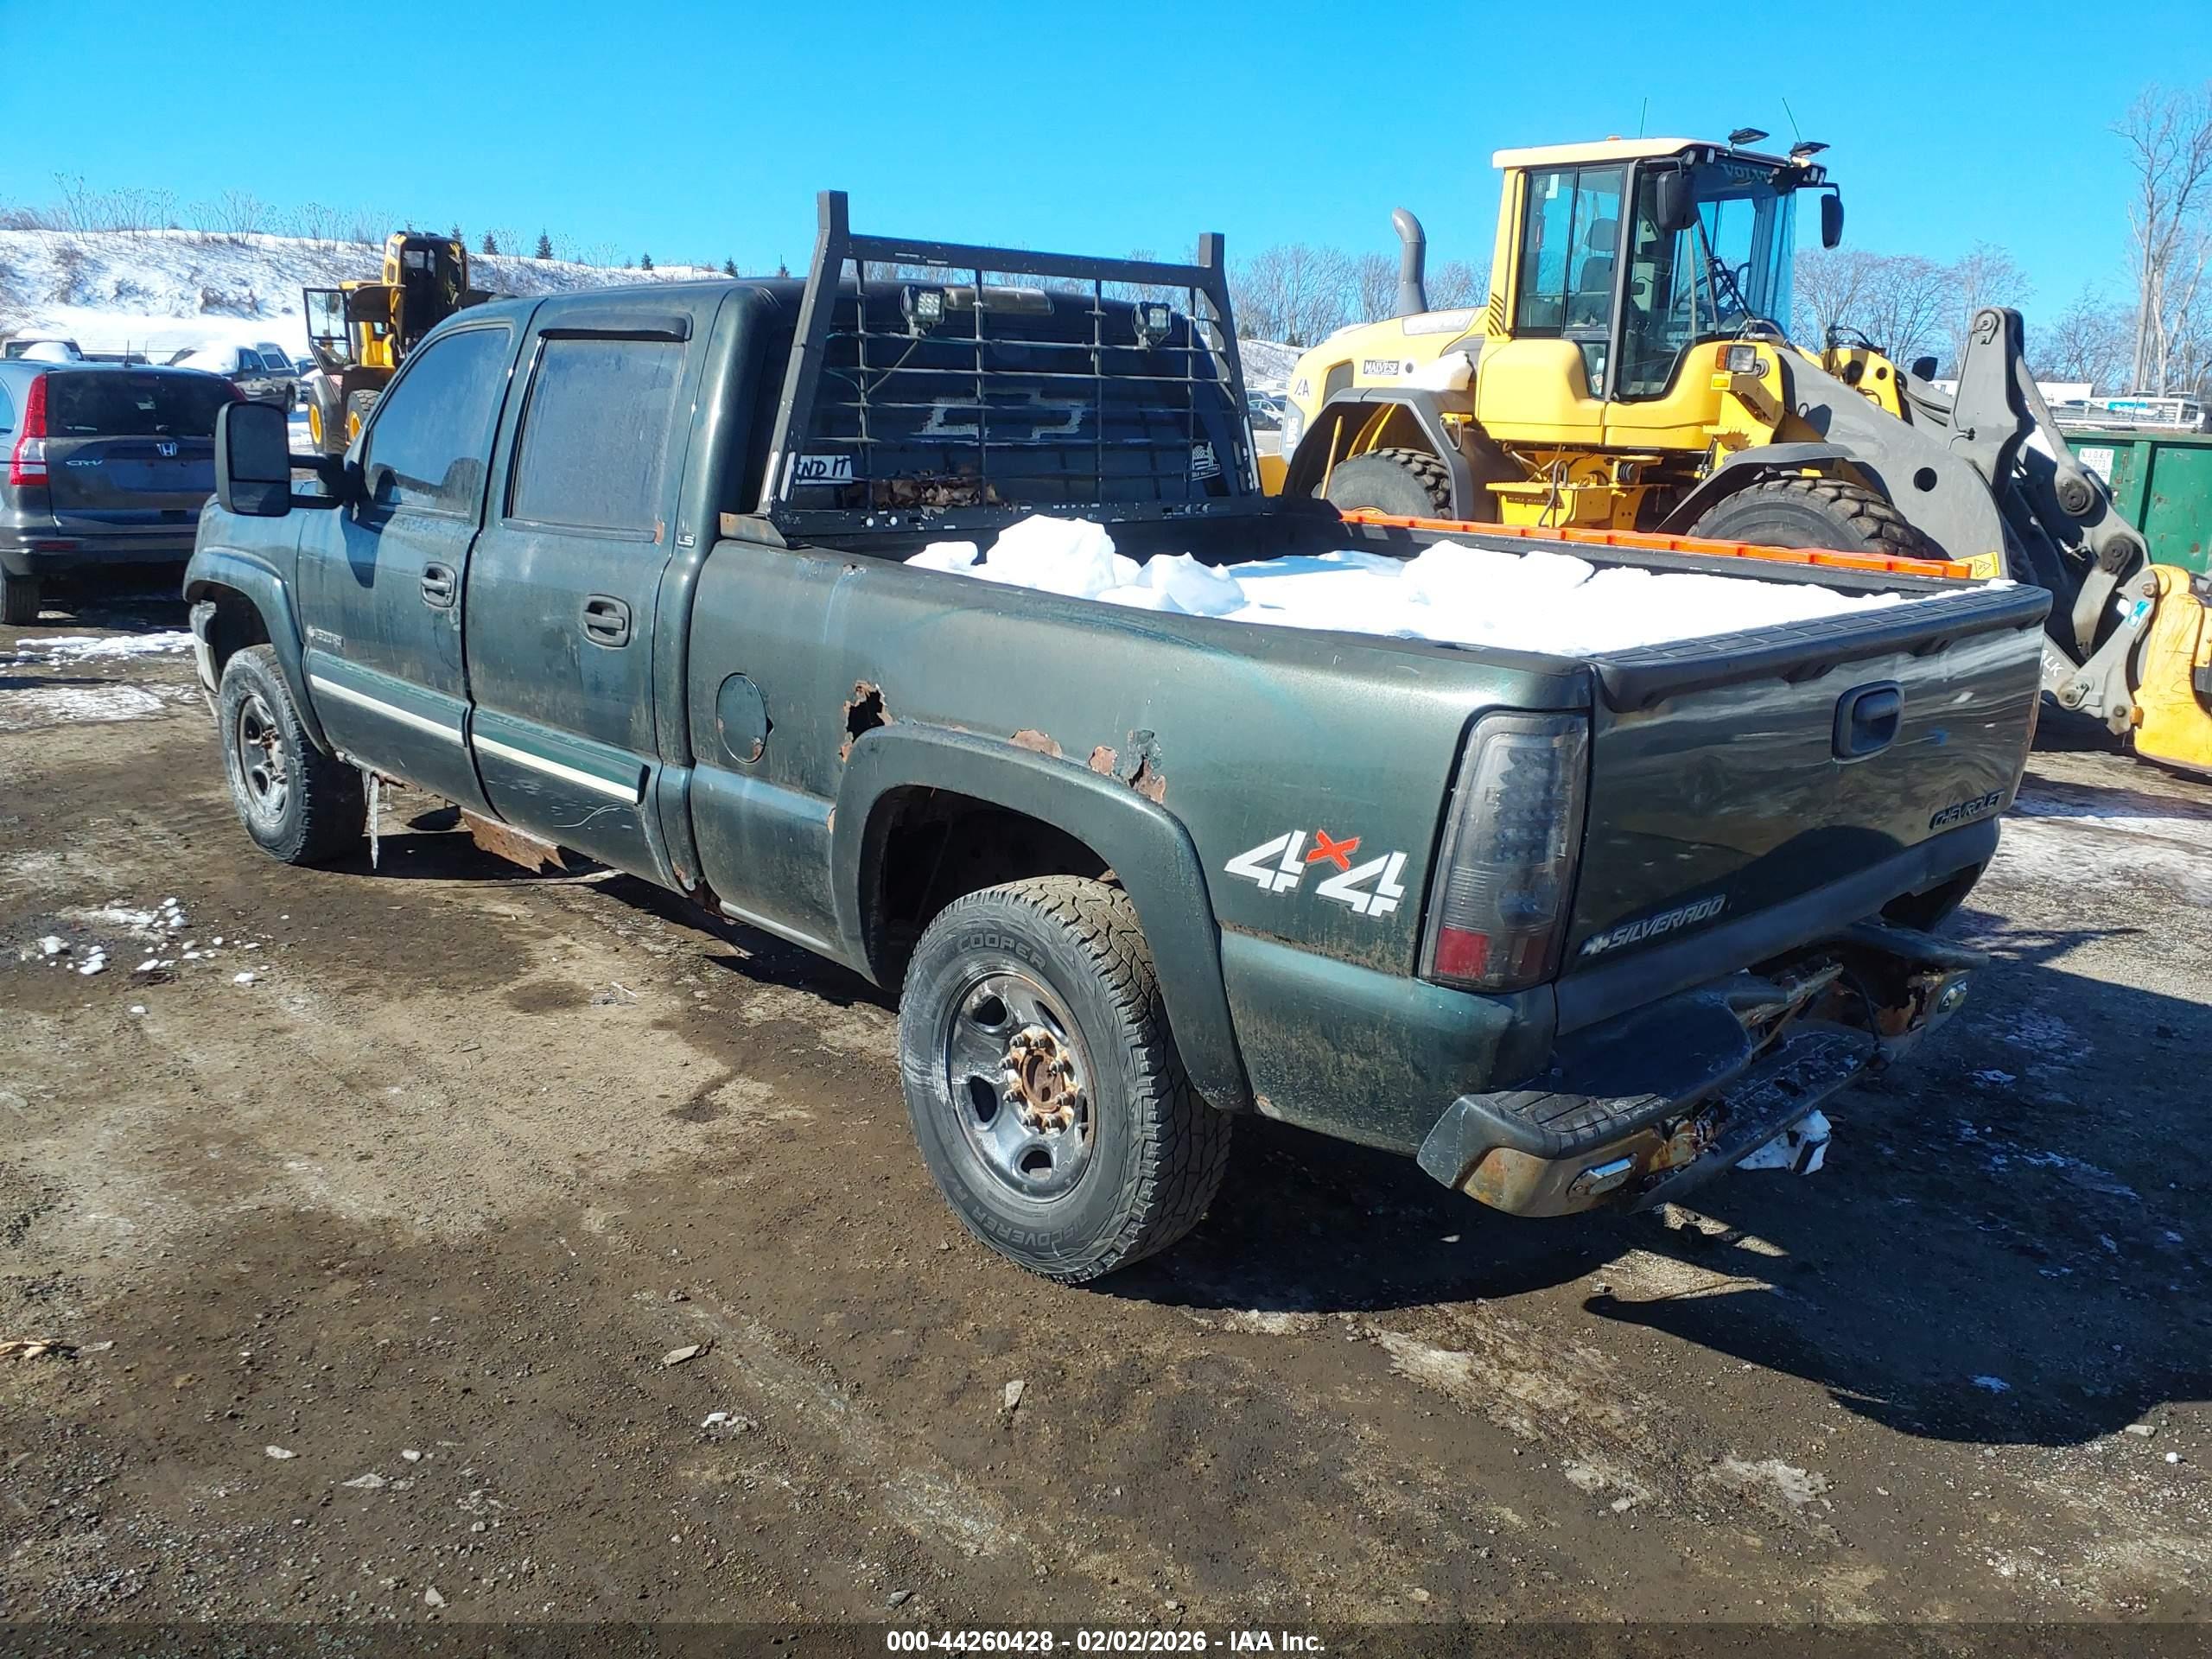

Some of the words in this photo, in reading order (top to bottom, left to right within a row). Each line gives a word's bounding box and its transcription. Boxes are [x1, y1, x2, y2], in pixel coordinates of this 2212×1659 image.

[832, 456, 851, 477] IT
[677, 533, 696, 547] LS
[1930, 788, 2005, 830] CHEVROLET
[1608, 893, 1726, 950] SILVERADO
[957, 932, 1046, 969] COOPER
[970, 1205, 1090, 1247] DISCOVERER
